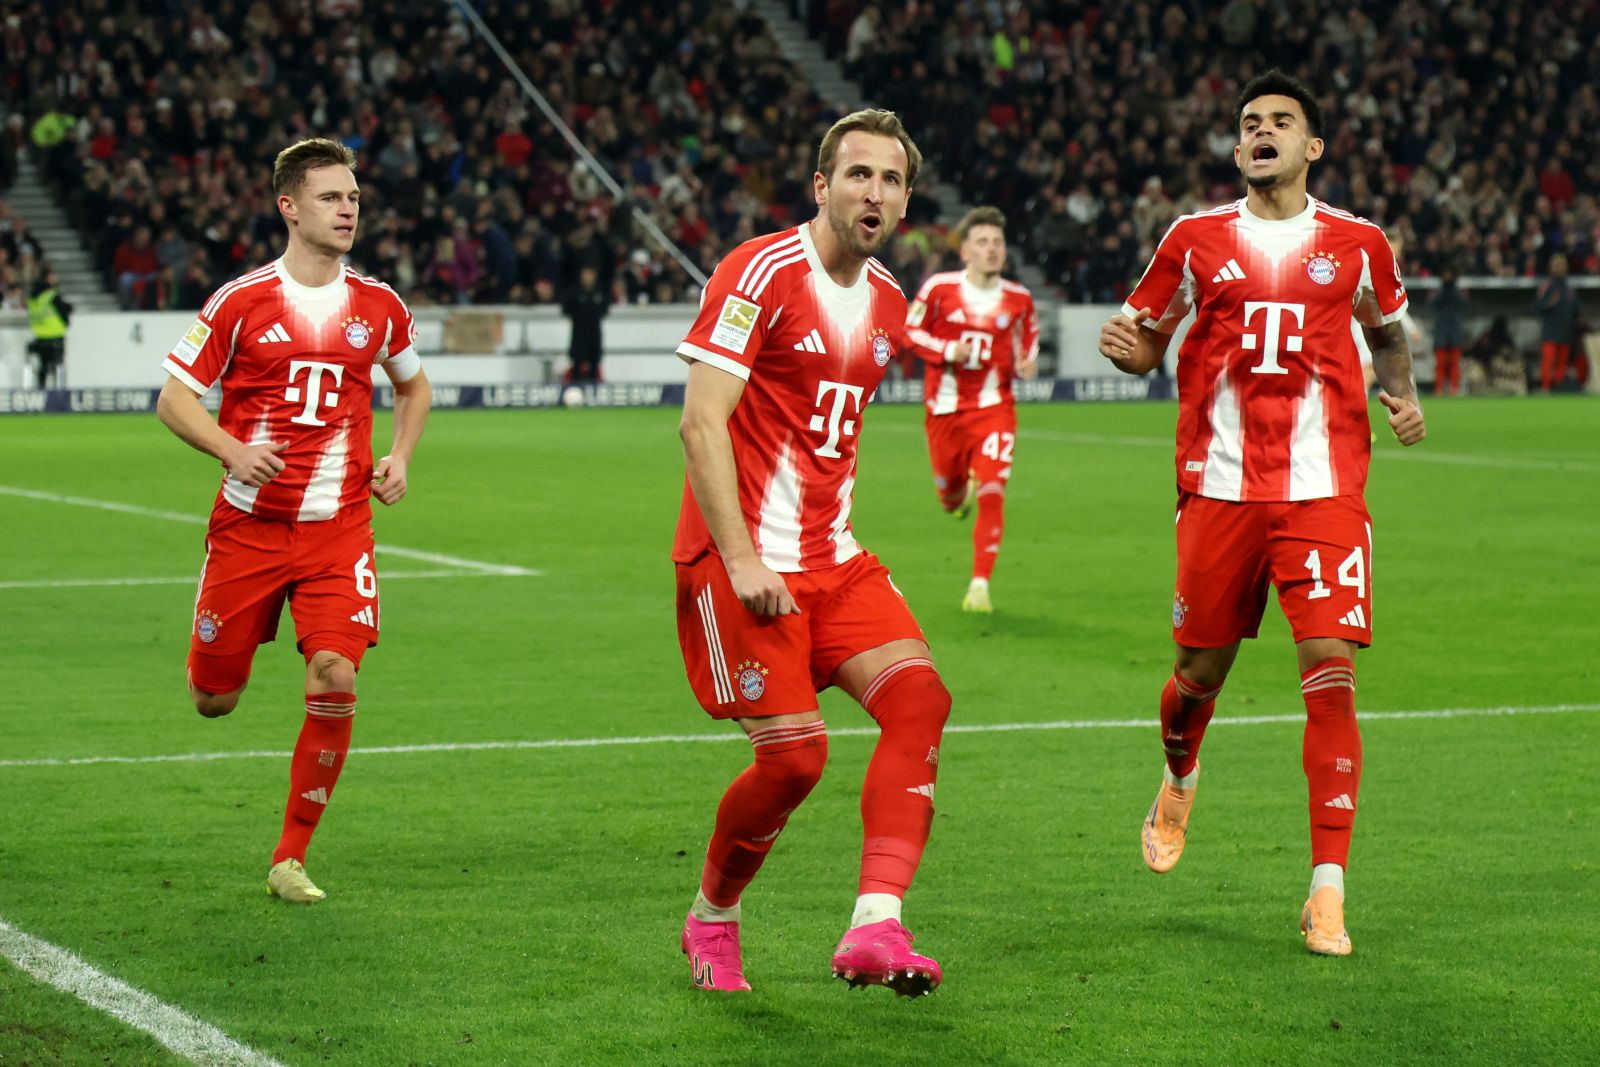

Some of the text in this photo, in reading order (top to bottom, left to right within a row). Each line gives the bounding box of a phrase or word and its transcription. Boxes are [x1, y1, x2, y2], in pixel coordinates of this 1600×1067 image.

[1242, 302, 1305, 374] T
[285, 361, 344, 426] T
[810, 381, 864, 459] T
[981, 431, 1015, 463] 42
[354, 552, 377, 599] 6
[1304, 546, 1366, 600] 14
